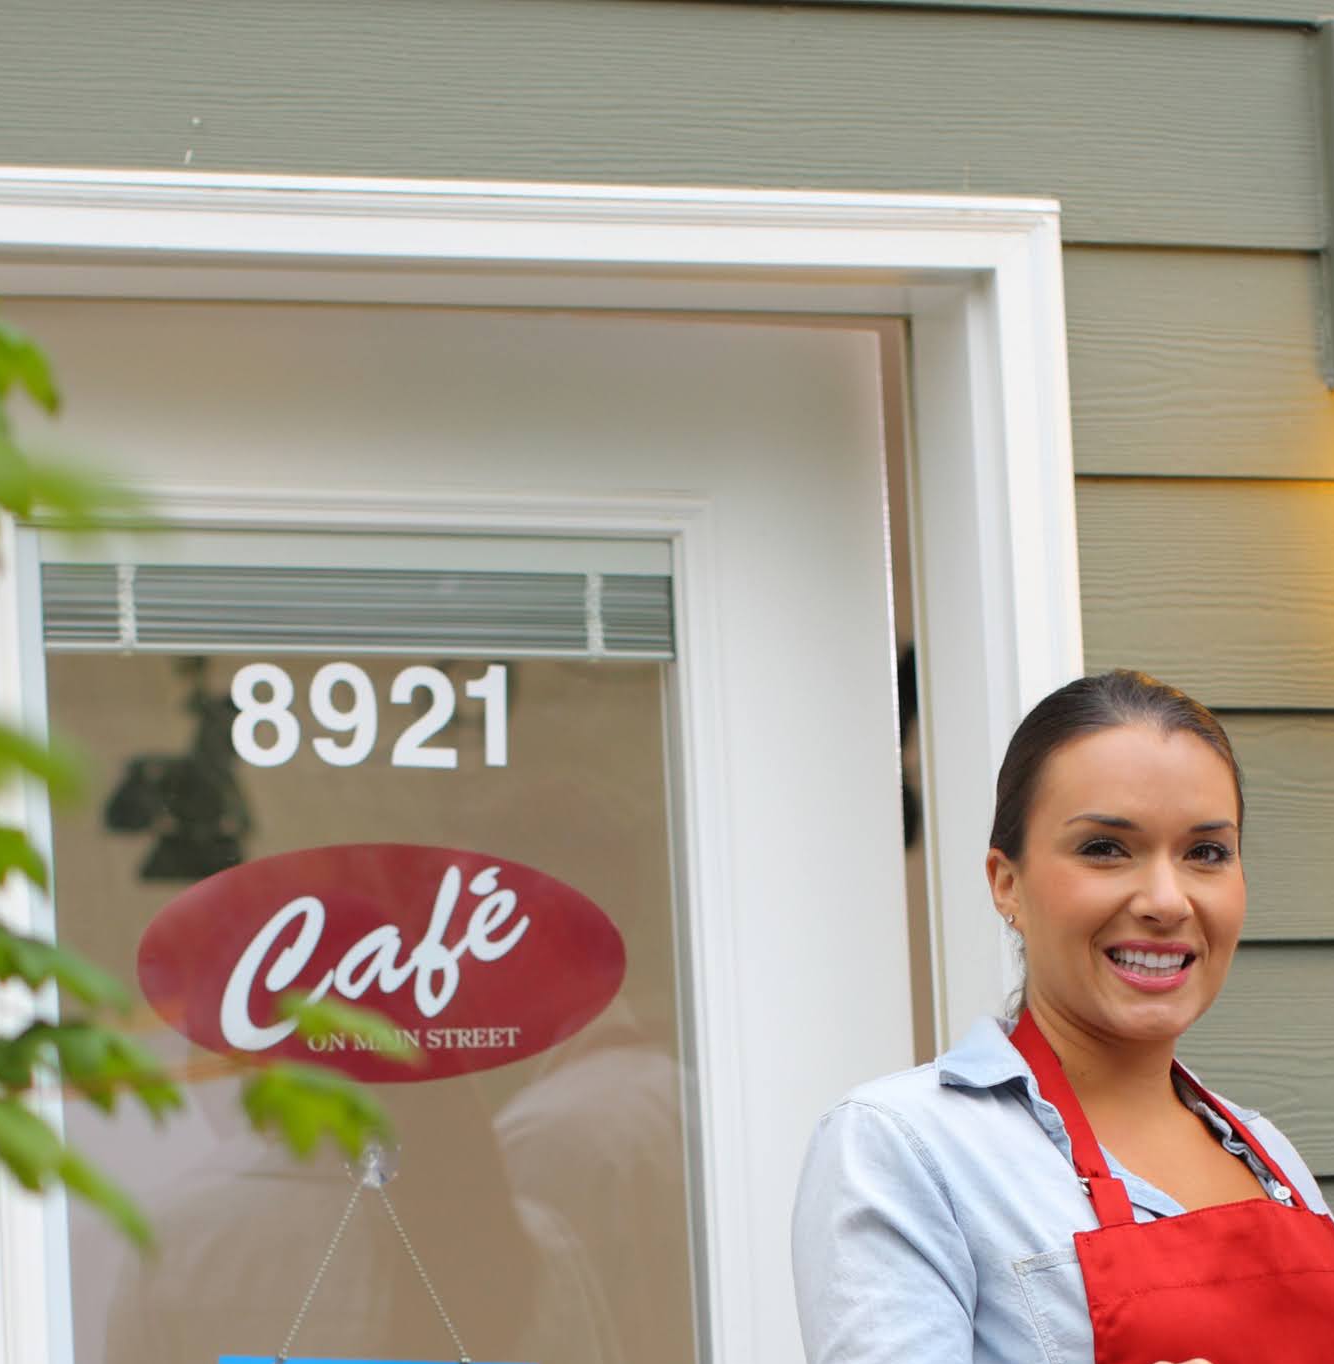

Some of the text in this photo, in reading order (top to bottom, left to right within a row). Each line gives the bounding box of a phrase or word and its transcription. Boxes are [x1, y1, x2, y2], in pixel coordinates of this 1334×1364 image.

[230, 661, 509, 769] 8921
[220, 864, 531, 1051] Café
[307, 1027, 520, 1052] ON MIN STREET
